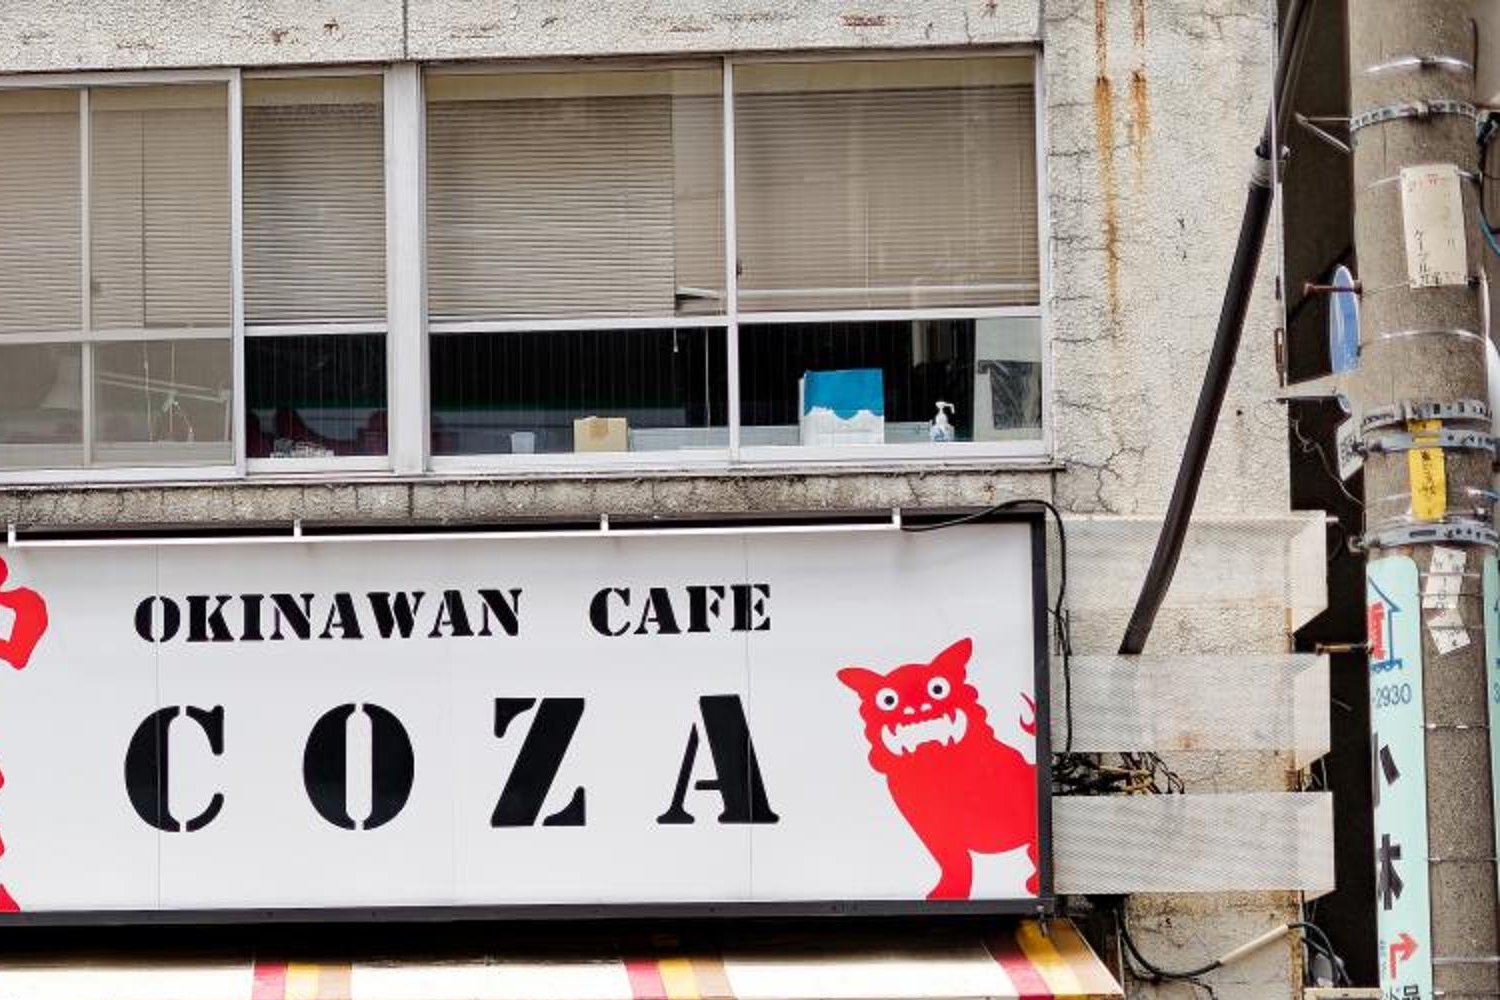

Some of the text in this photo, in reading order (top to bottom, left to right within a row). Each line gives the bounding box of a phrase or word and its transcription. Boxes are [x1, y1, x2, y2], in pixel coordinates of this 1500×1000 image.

[133, 583, 772, 643] OKINAWAN CAFE
[124, 694, 780, 833] COZA
